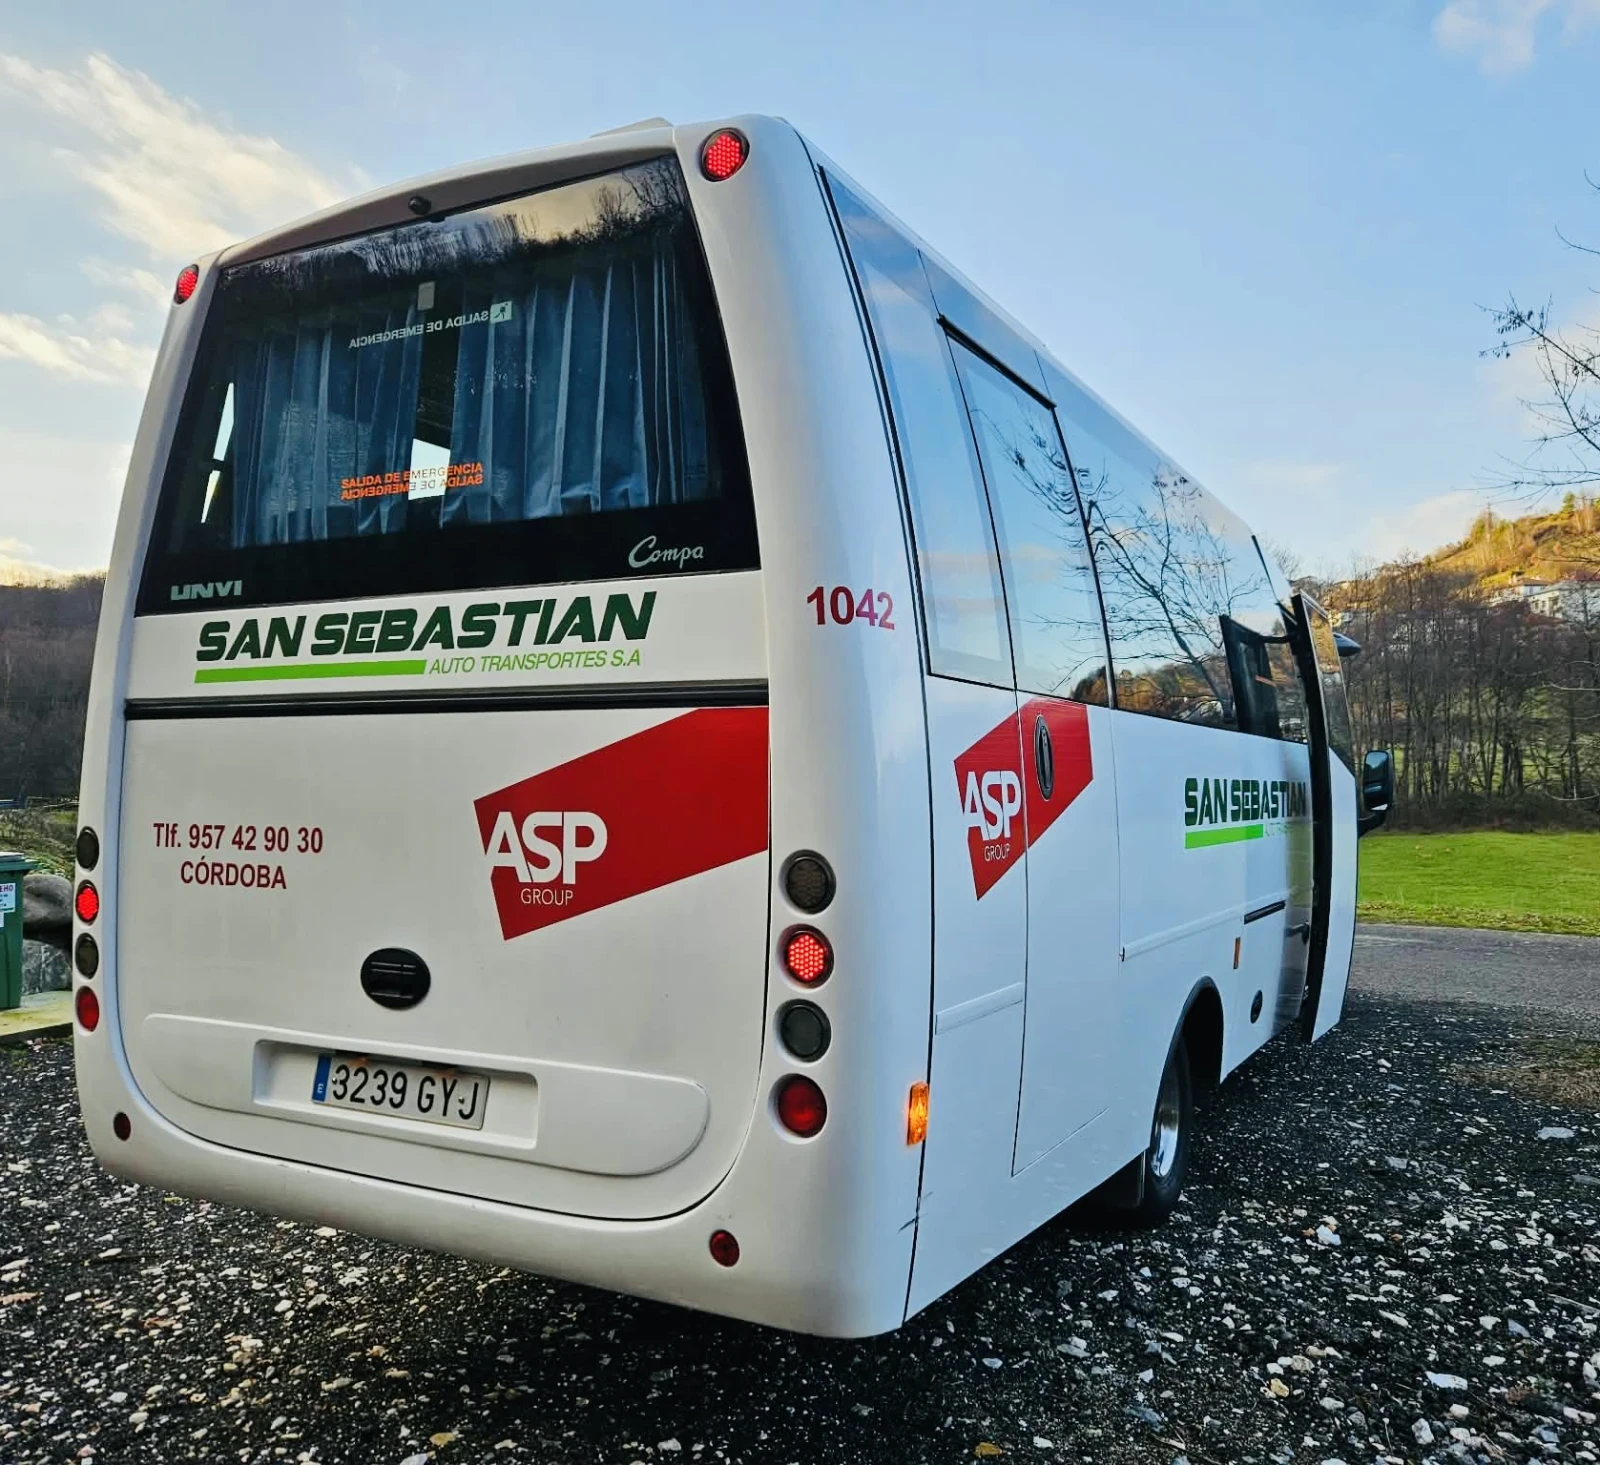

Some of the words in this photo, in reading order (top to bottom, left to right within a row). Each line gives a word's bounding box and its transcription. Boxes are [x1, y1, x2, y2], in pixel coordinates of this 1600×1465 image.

[341, 474, 382, 489] SALIDA
[384, 472, 400, 484] DE
[403, 462, 483, 480] EMERGENCIA
[628, 535, 704, 569] Compa
[171, 579, 242, 600] UNVI
[807, 586, 895, 630] 1042
[196, 615, 307, 661] SAN
[310, 591, 657, 656] SEBASTIAN
[429, 656, 475, 674] AUTO
[480, 650, 607, 672] TRANSPORTES
[610, 649, 641, 667] S.A
[961, 770, 1021, 841] ASP
[1185, 777, 1228, 827] SAN
[1230, 779, 1306, 822] SEBASTIAN
[153, 823, 181, 848] Tlf.
[188, 823, 226, 850] 957
[231, 825, 257, 851] 42
[264, 826, 289, 852] 90
[297, 827, 323, 854] 30
[482, 810, 608, 884] ASP
[984, 843, 1011, 862] GROUP
[180, 855, 287, 889] CÓRDOBA
[520, 888, 574, 905] GROUP
[332, 1064, 408, 1110] 3239
[417, 1075, 480, 1120] GYJ
